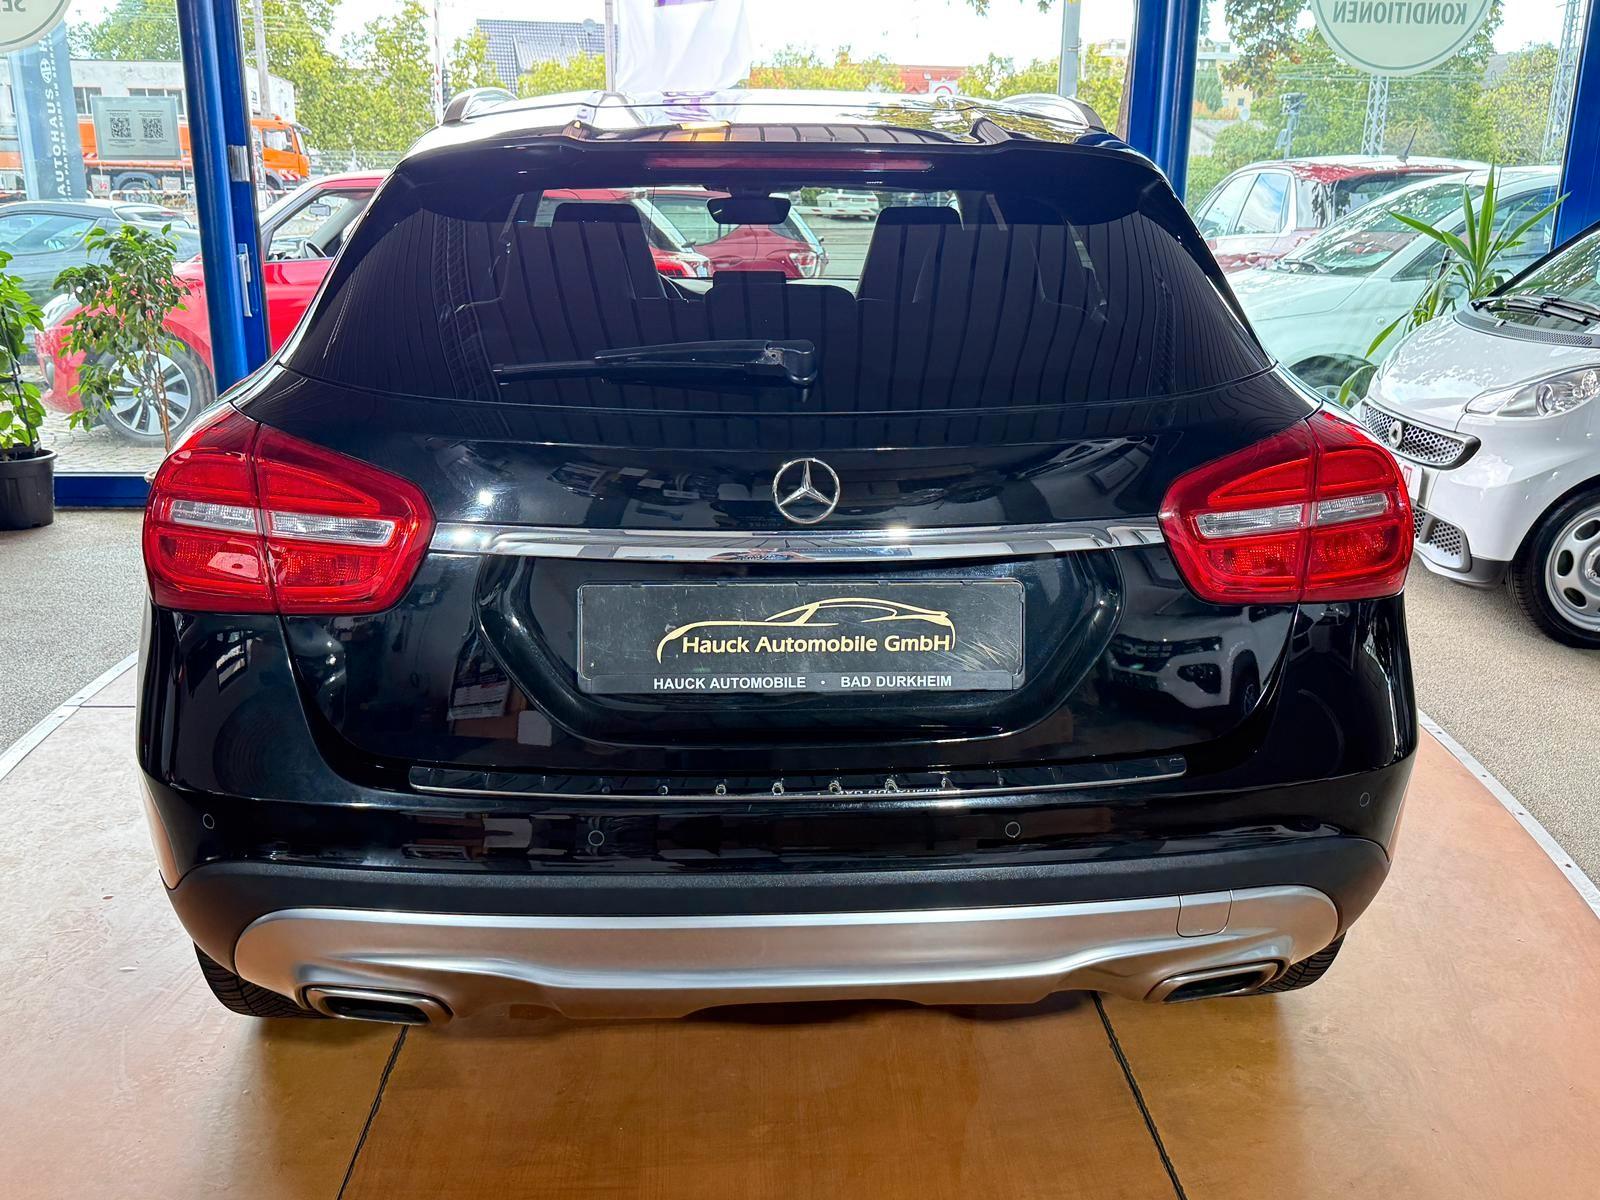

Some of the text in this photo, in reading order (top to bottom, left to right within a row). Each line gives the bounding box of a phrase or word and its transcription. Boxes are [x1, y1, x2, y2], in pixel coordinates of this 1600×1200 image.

[45, 88, 66, 196] AUTOHAUS
[682, 635, 950, 654] Hauck Automobile GmbH
[653, 676, 952, 690] HAUCK AUTOMOBILE BAD DURKHEIM
